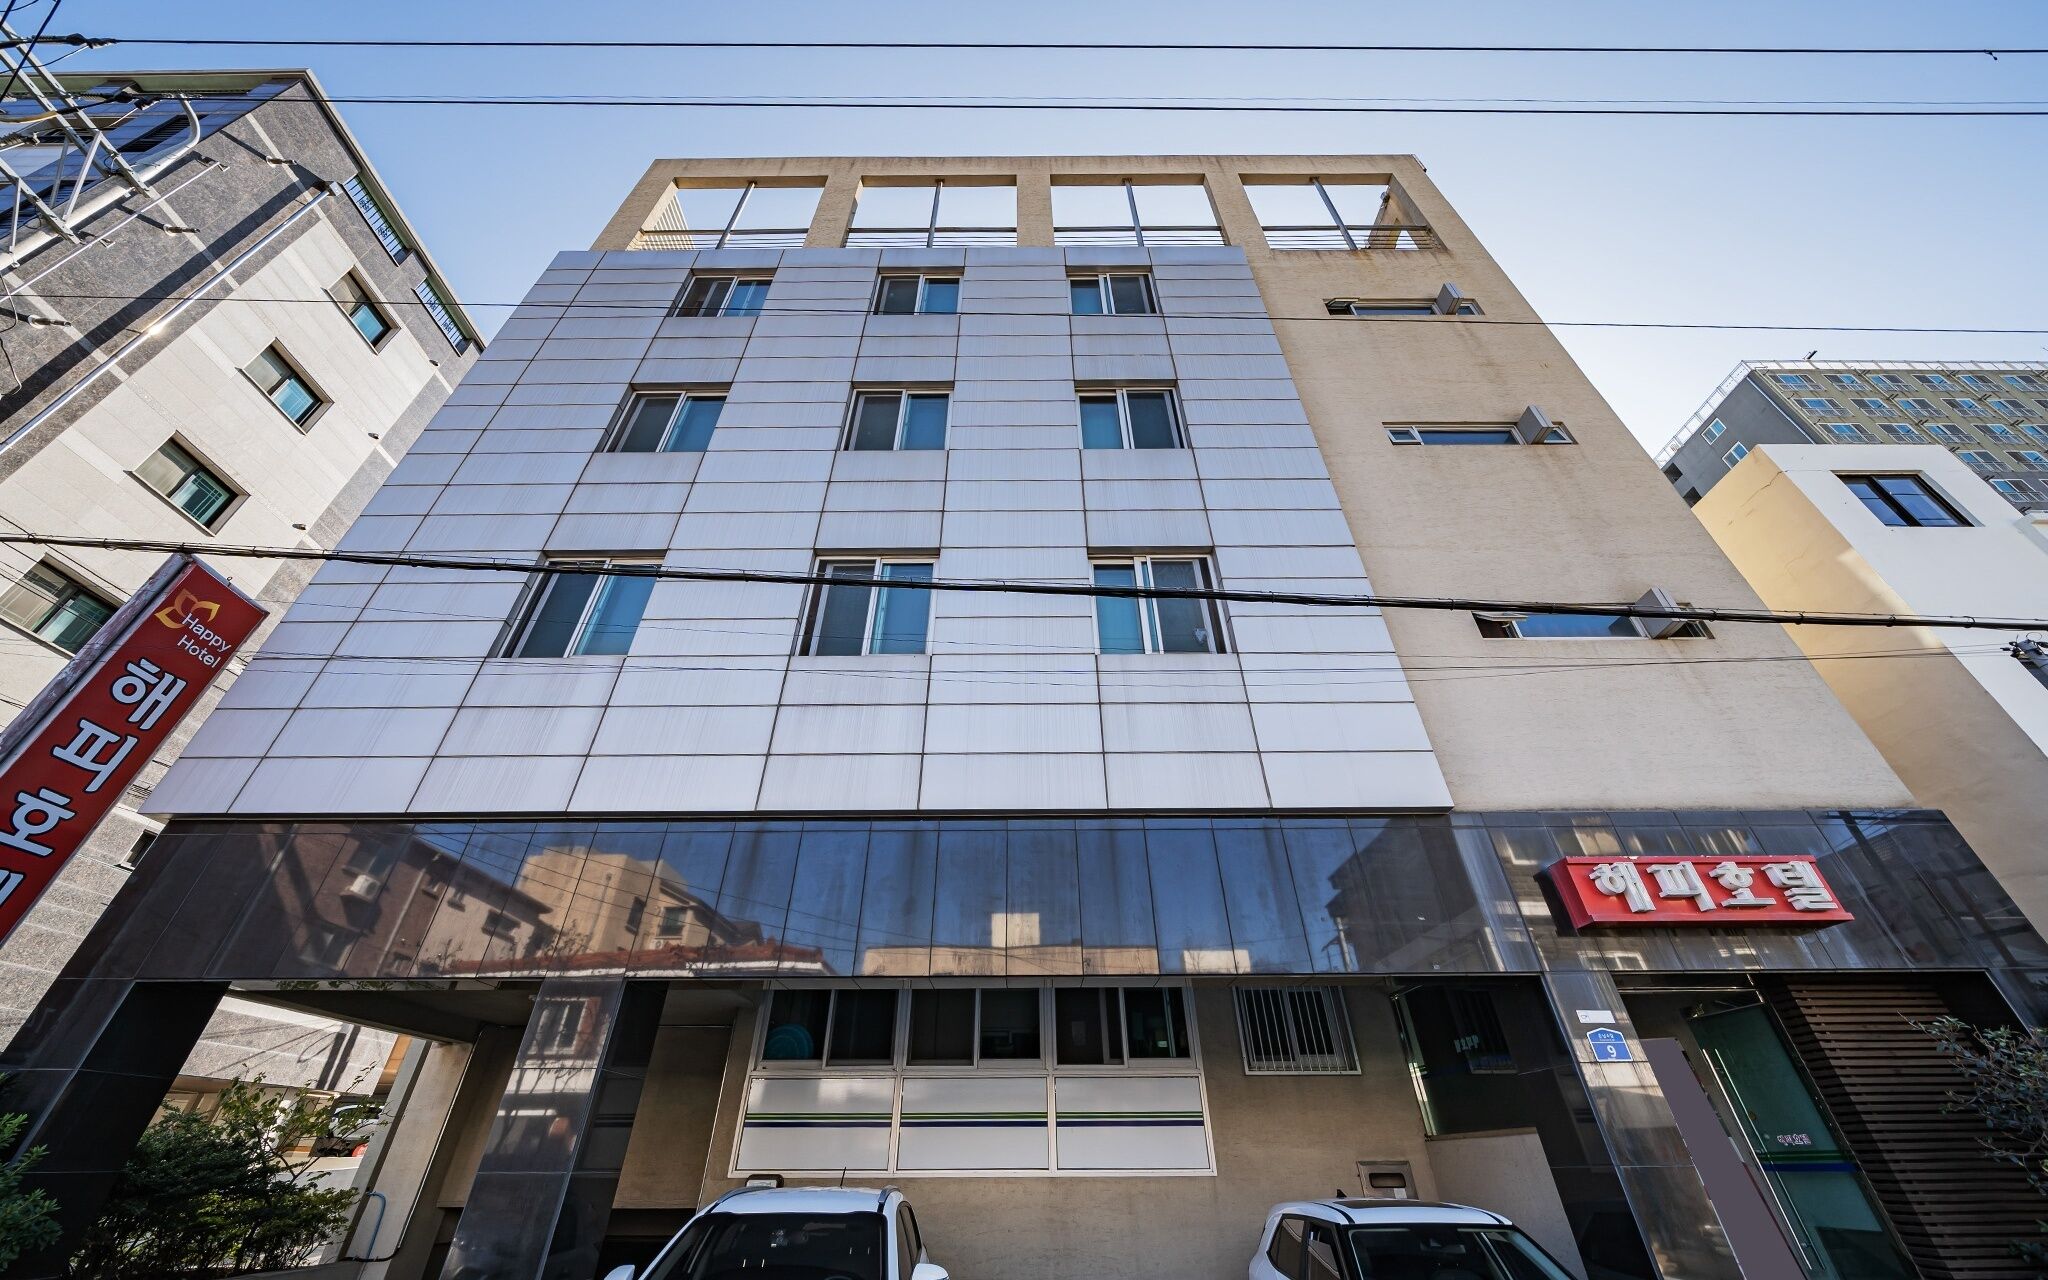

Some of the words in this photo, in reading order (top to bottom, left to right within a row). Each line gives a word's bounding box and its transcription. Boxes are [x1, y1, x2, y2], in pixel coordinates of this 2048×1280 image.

[177, 634, 221, 668] Hotel
[181, 612, 232, 653] Happy
[1588, 860, 1838, 913] 해피호텔
[1606, 1045, 1617, 1058] 9
